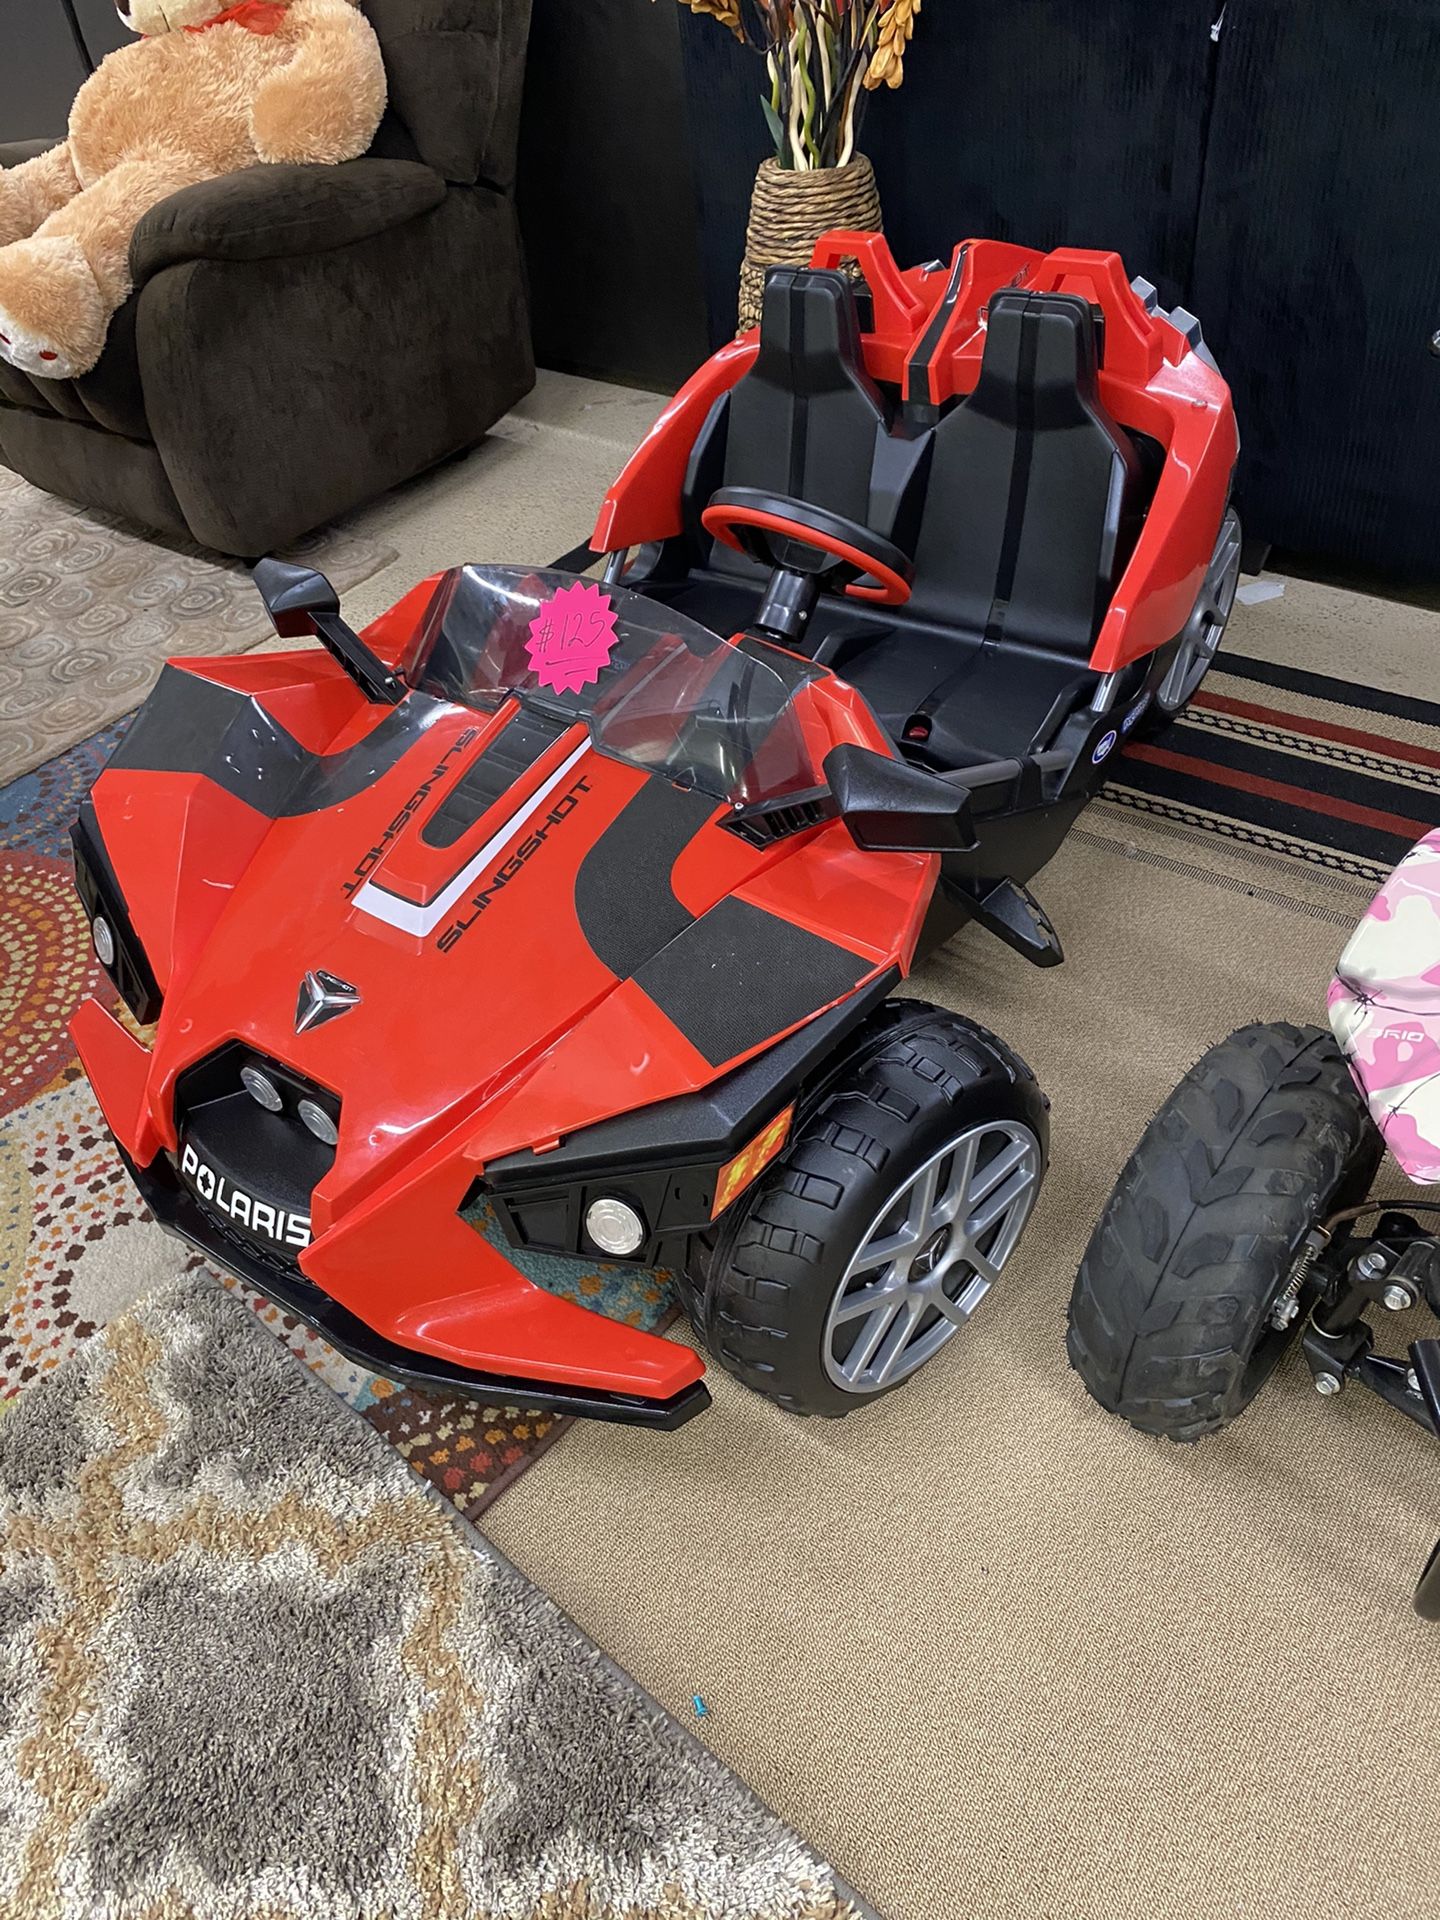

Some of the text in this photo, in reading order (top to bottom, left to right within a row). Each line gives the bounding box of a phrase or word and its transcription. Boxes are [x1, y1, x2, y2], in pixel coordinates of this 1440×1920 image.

[536, 611, 605, 653] $125
[341, 727, 479, 899] SLINGSHOT
[436, 775, 592, 953] SLINGSHOT
[182, 1144, 311, 1247] POLARIS
